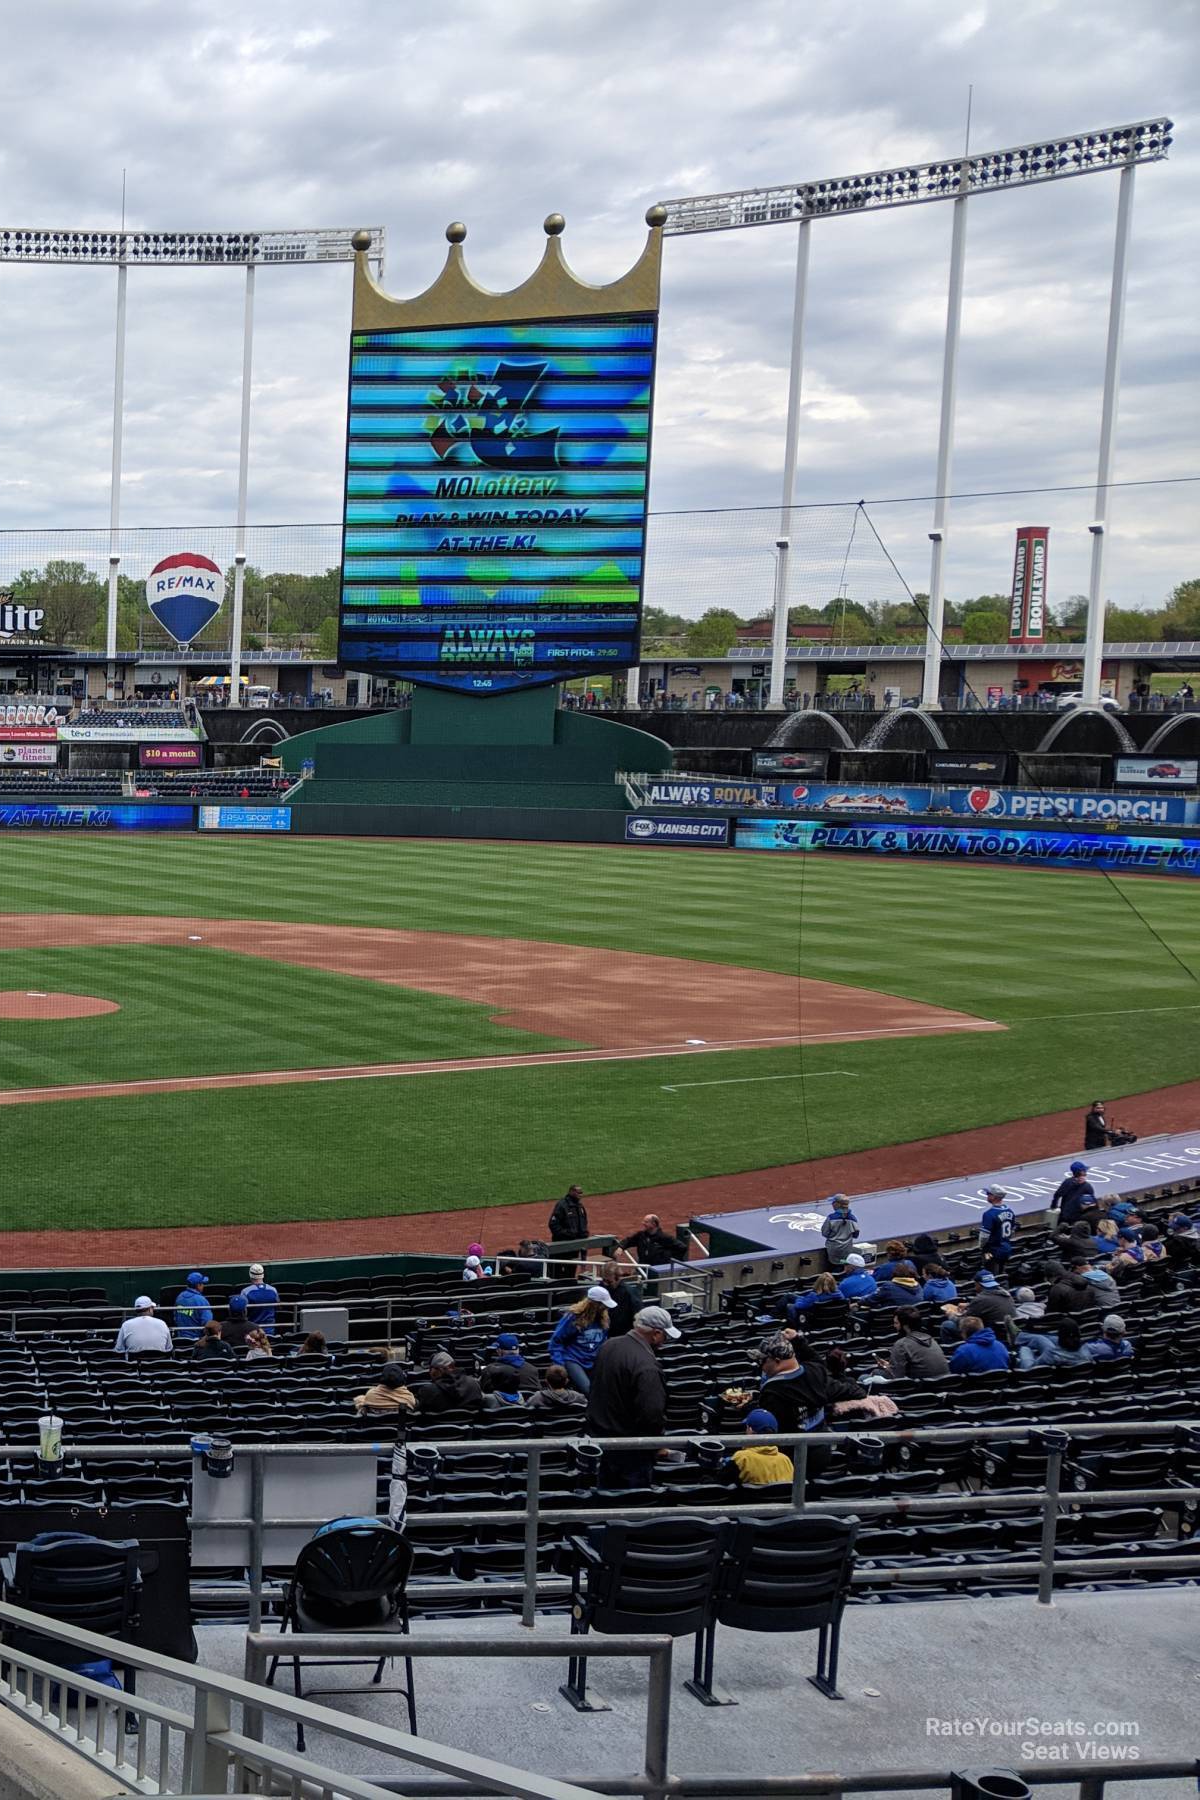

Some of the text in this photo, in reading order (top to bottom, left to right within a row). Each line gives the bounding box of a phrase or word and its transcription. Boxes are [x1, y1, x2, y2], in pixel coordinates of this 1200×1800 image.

[435, 476, 557, 499] MOLottery
[513, 507, 590, 524] TODAY
[436, 534, 538, 551] AT THE K!
[156, 575, 216, 592] RE/MAX
[1011, 546, 1026, 630] BOULEVARD
[1028, 545, 1044, 629] BOULEVARD
[440, 630, 536, 652] ALWAYS
[547, 649, 569, 657] FIRST
[571, 649, 596, 657] PITCH:
[70, 729, 91, 738] teva
[17, 746, 46, 755] planet
[22, 753, 52, 761] fitness
[145, 750, 161, 758] $10
[169, 750, 197, 758] month
[650, 785, 711, 801] ALWAYS
[1010, 796, 1168, 821] PEPSI PORCH
[10, 810, 41, 827] AT
[42, 810, 84, 827] THE
[86, 810, 112, 827] K!
[634, 823, 725, 836] FOX KANSAS CITY
[810, 828, 879, 848] PLAY
[880, 831, 900, 849] &
[906, 832, 960, 853] WIN
[966, 836, 1062, 858] TODAY
[1051, 840, 1099, 862] AT
[1107, 842, 1164, 866] THE
[1110, 1153, 1188, 1173] THE
